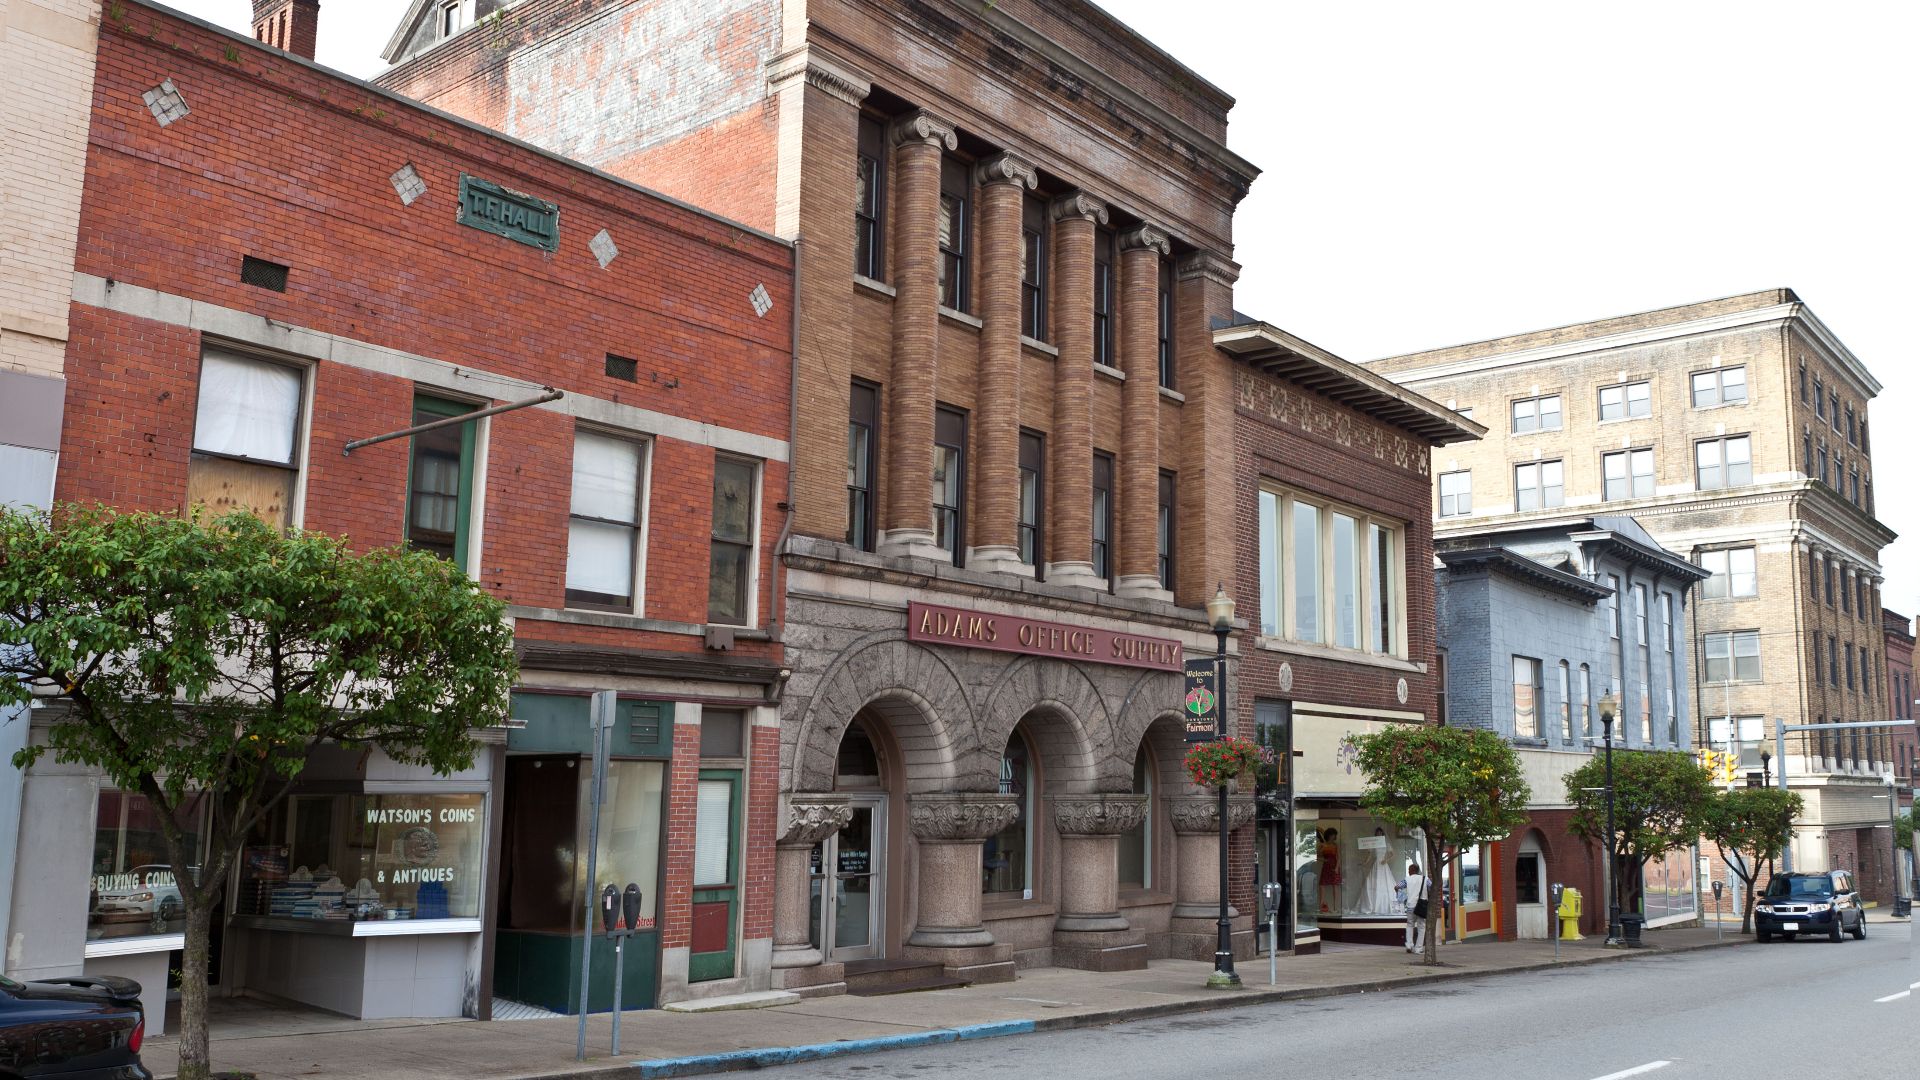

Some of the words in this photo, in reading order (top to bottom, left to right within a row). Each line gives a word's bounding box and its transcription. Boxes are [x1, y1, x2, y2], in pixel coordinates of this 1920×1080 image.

[919, 609, 997, 643] ADAMS
[1018, 623, 1095, 655] OFFICE
[1112, 636, 1178, 665] SUPPLY
[1186, 670, 1214, 678] Welcome
[1186, 723, 1214, 732] Fairmont
[367, 808, 432, 824] WATSON'S
[440, 808, 475, 823] COINS
[145, 871, 177, 888] COINS
[377, 870, 385, 883] &
[392, 867, 454, 884] ANTIQUES
